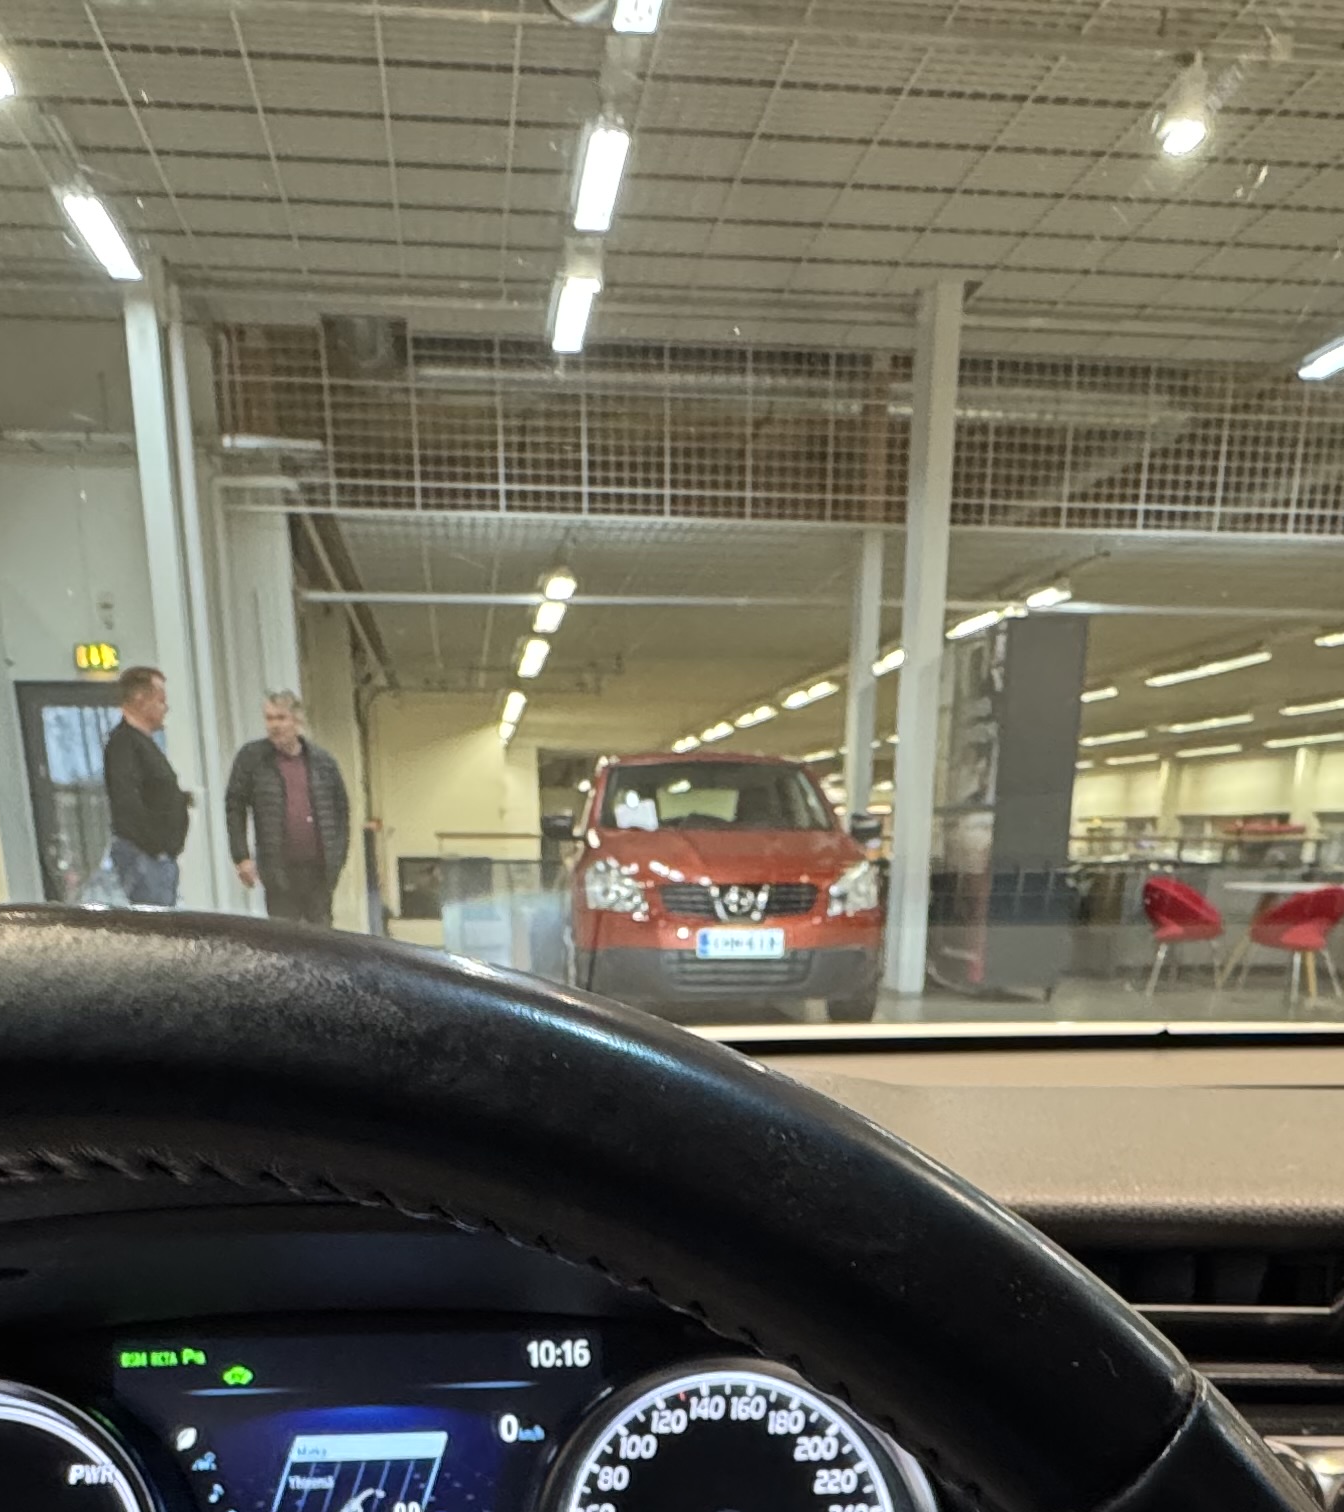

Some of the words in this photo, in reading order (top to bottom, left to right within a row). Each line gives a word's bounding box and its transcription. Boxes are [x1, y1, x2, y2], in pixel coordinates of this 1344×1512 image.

[526, 1339, 591, 1368] 10:16
[690, 1395, 725, 1421] 140
[730, 1395, 767, 1421] 160
[498, 1414, 518, 1442] 0
[651, 1409, 688, 1434] 120
[768, 1409, 806, 1435] 180
[618, 1434, 657, 1460] 100
[793, 1436, 839, 1461] 200
[67, 1464, 117, 1487] PWR
[597, 1465, 630, 1491] 80
[813, 1468, 858, 1495] 220
